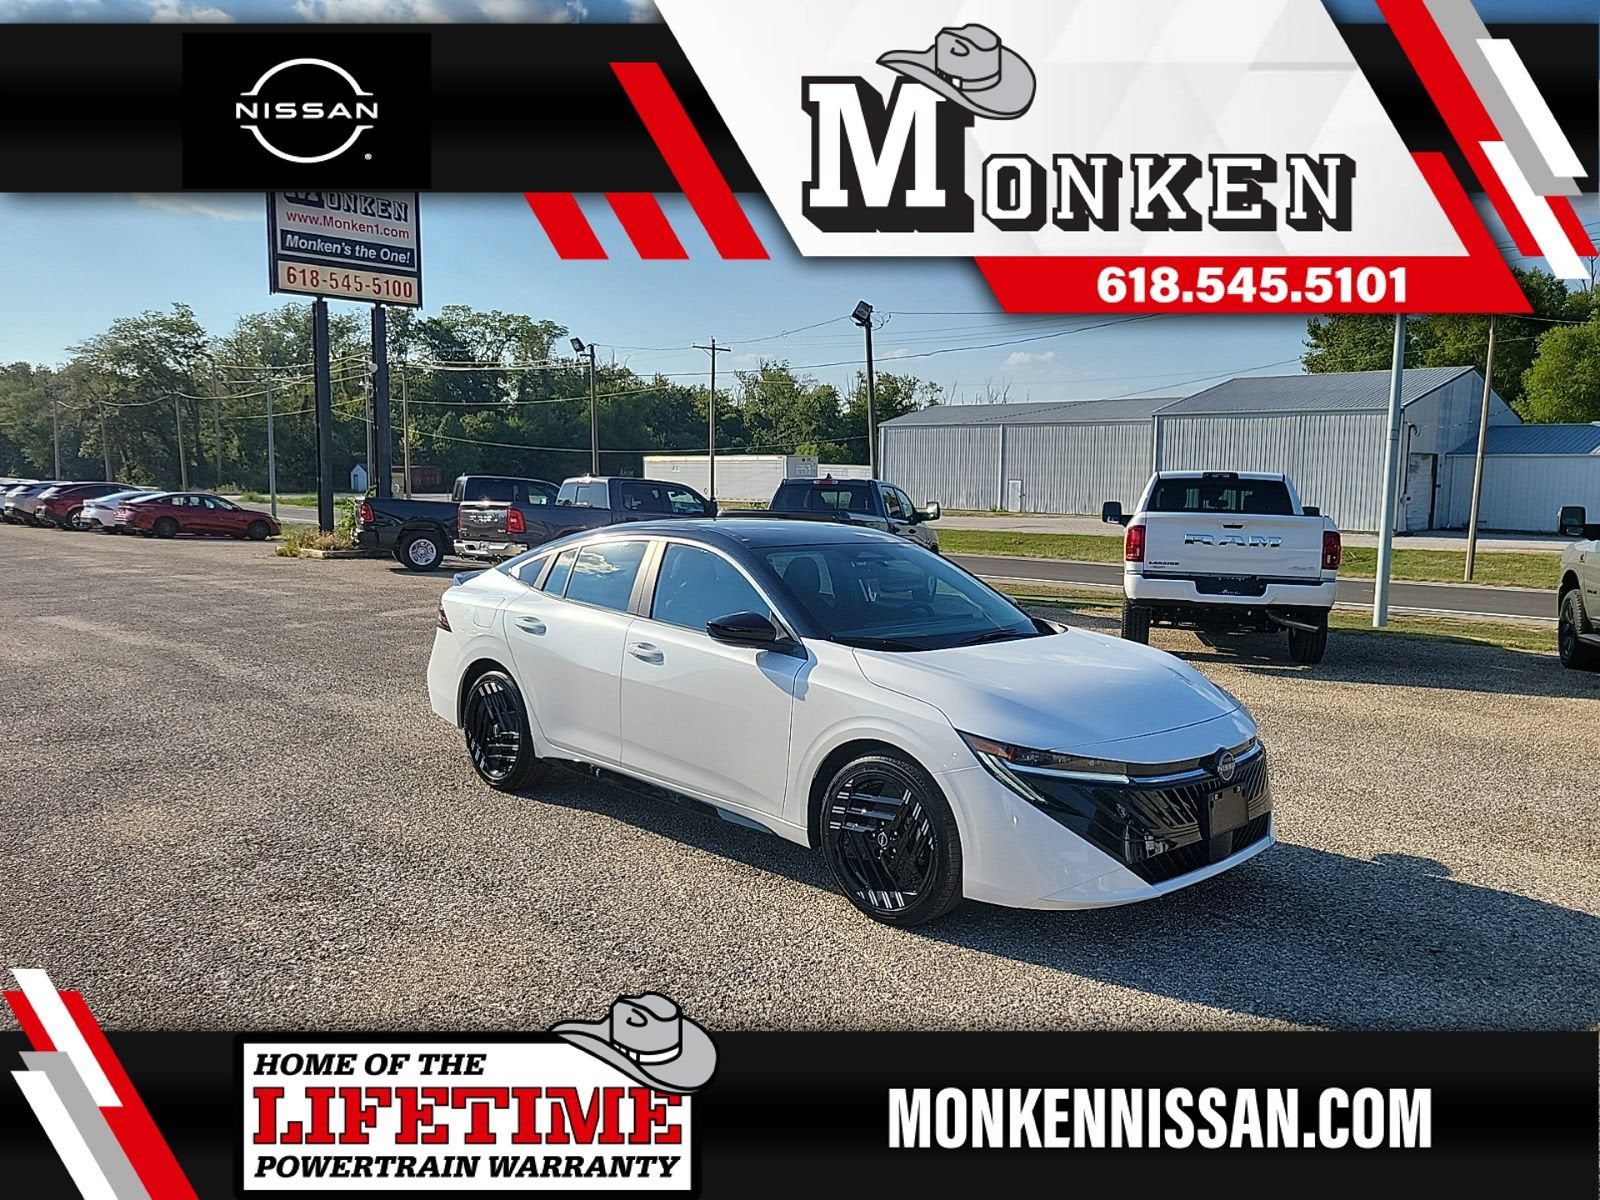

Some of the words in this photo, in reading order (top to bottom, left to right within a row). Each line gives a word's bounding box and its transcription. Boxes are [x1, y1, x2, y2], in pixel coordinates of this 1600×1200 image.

[286, 211, 410, 240] www.Monken1.com
[285, 234, 352, 256] Monken's
[354, 244, 377, 260] the
[380, 248, 411, 264] One!
[286, 265, 413, 298] 618-545-5100
[1184, 533, 1282, 548] RAM
